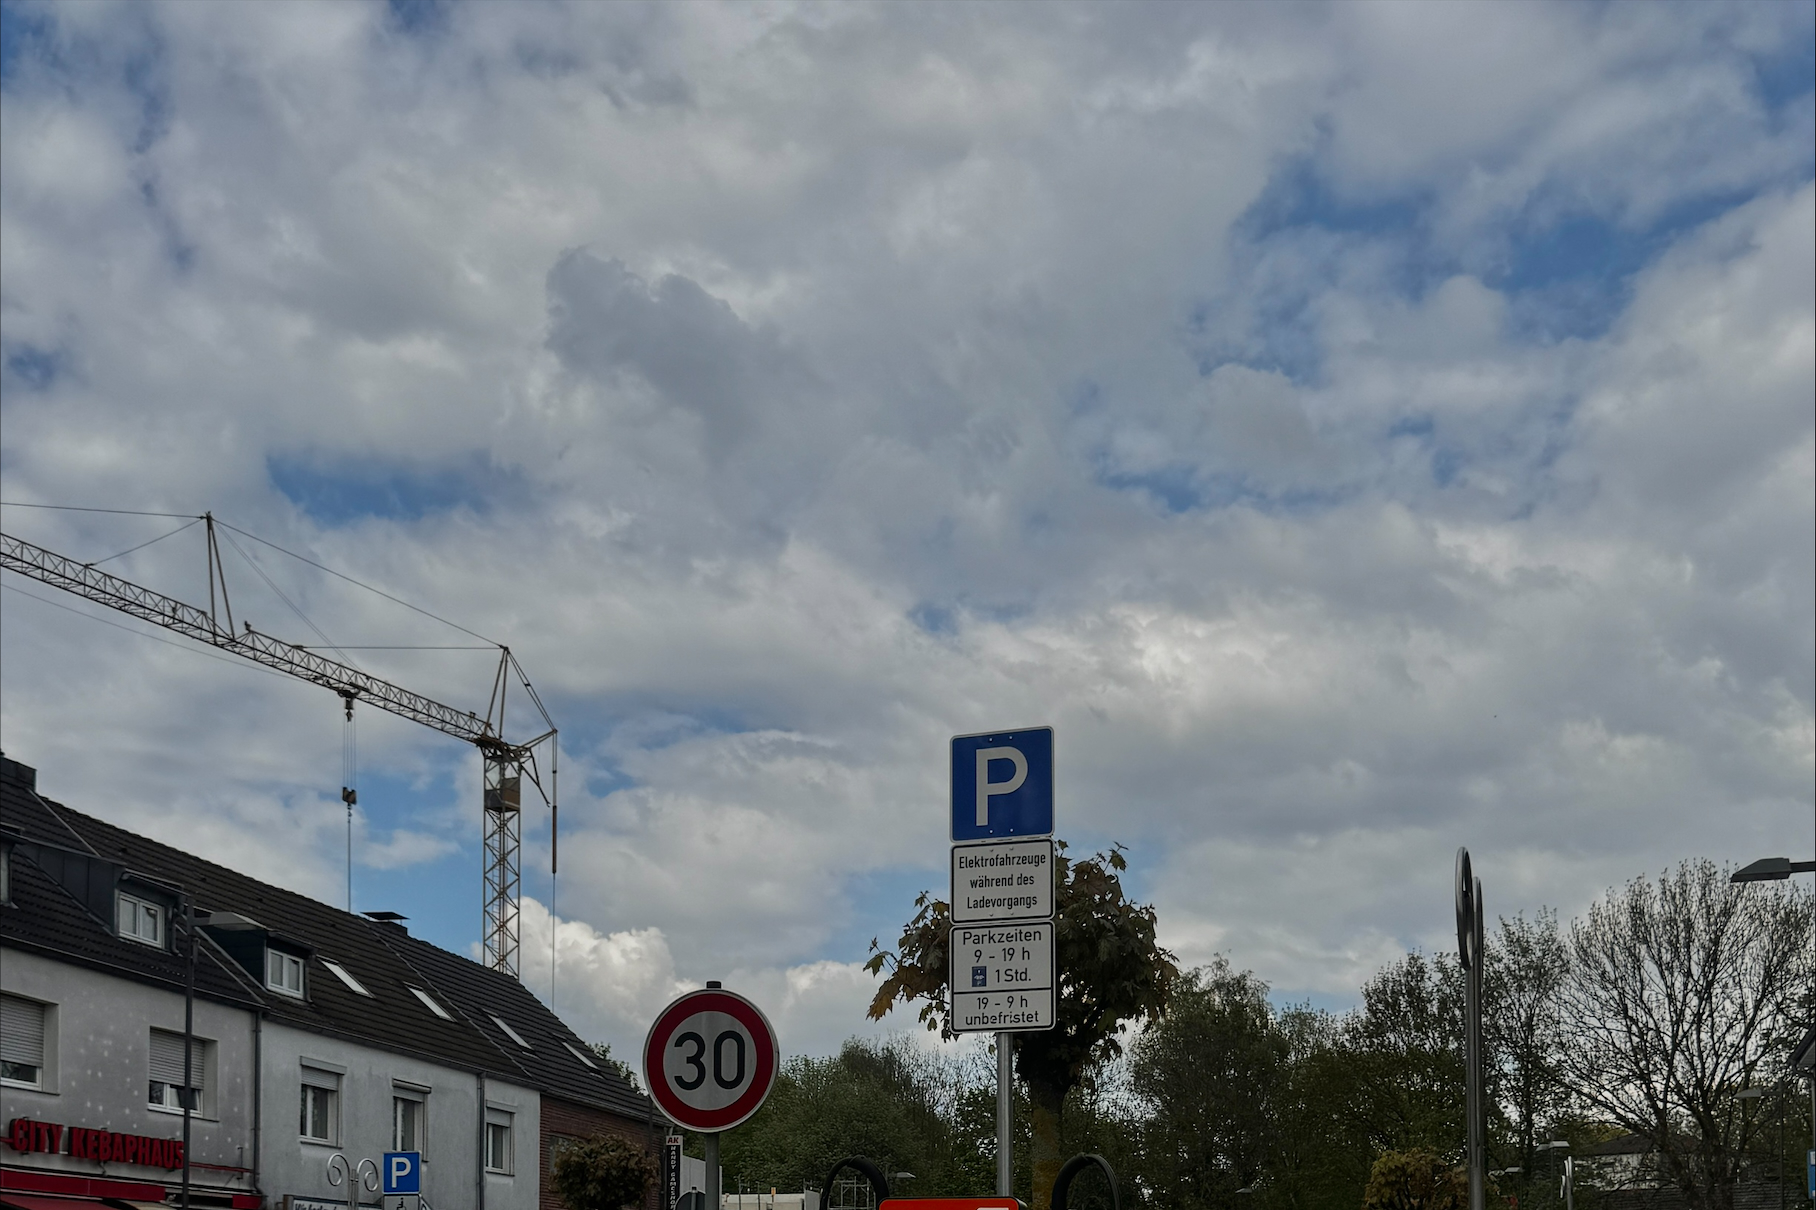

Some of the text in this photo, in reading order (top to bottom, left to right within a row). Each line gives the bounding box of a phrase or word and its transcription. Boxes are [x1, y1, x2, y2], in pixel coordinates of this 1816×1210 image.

[976, 745, 1029, 827] P
[959, 853, 1046, 869] Elektrofahrzeuge
[970, 873, 1035, 889] während des
[967, 896, 1038, 910] Ladevorgangs
[963, 928, 1042, 945] Parkzeiten
[974, 949, 982, 963] 9
[1002, 947, 1015, 962] 19
[1022, 947, 1030, 960] h
[995, 967, 1032, 983] 1 Std.
[977, 997, 989, 1010] 19
[1007, 995, 1014, 1009] 9
[1020, 995, 1028, 1008] h
[965, 1010, 1039, 1026] unbefristet
[674, 1030, 746, 1091] 30
[11, 1118, 185, 1170] CITY KEBAPHAUS
[391, 1156, 412, 1189] P
